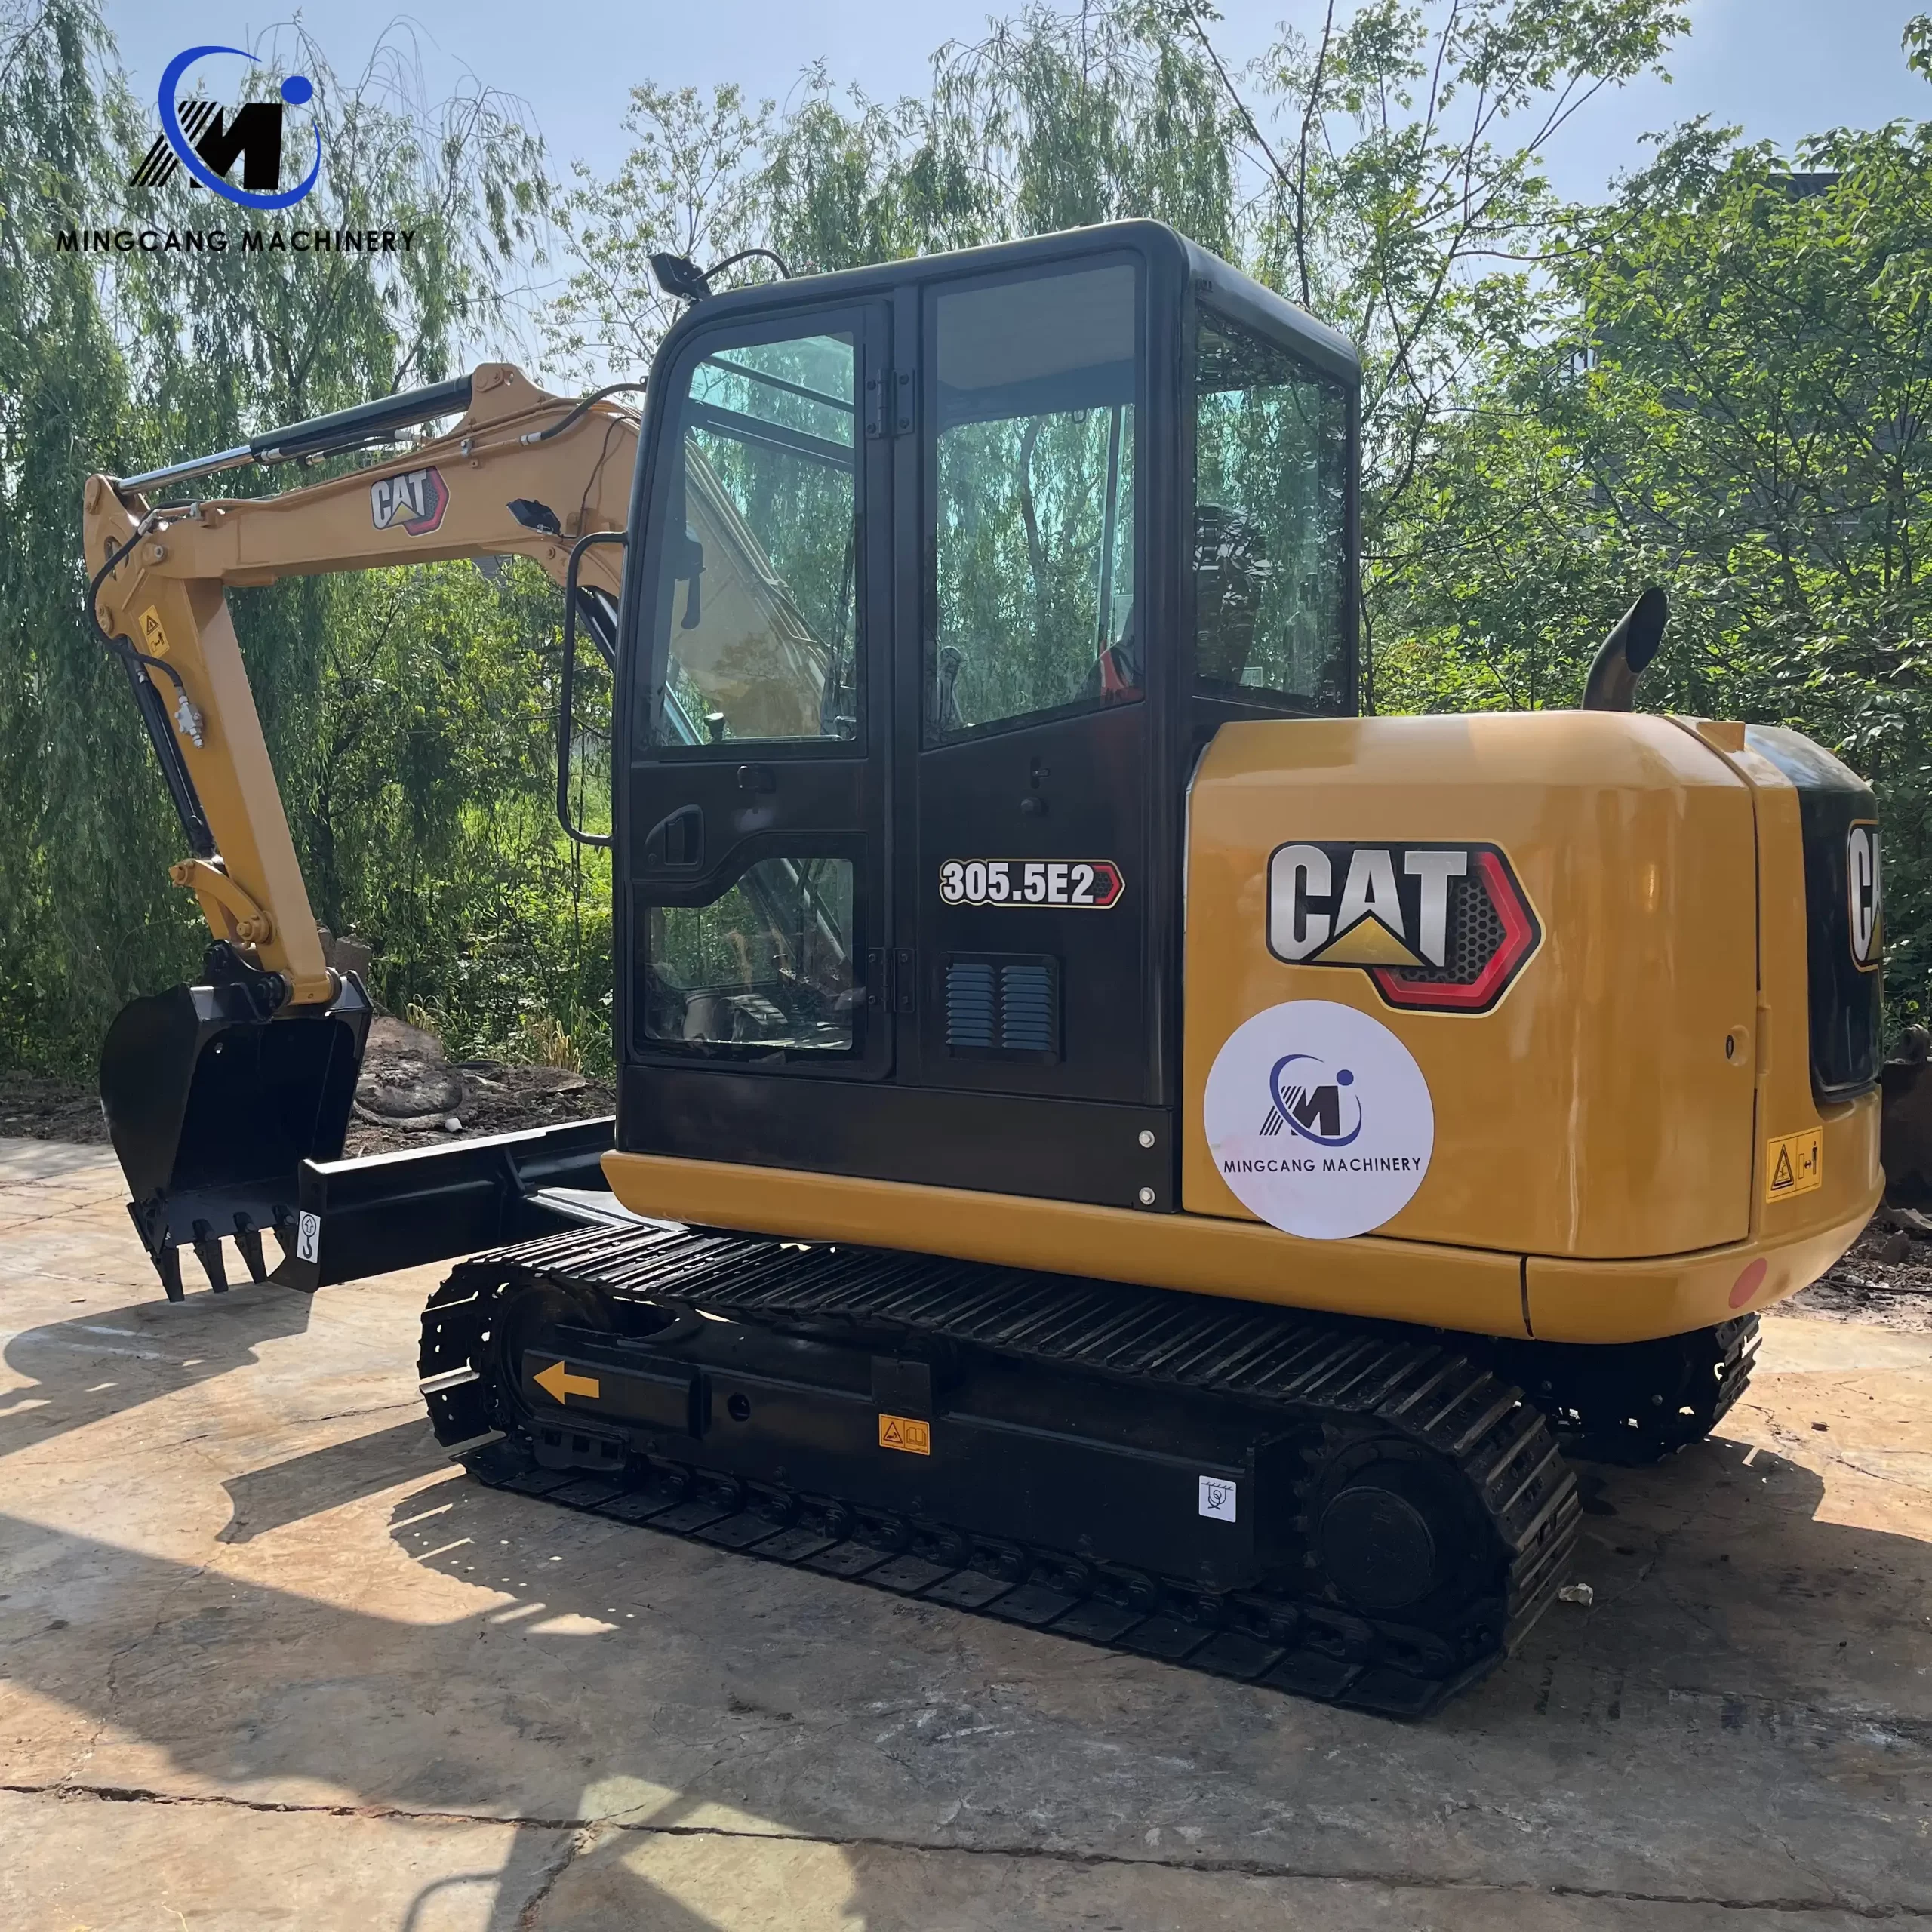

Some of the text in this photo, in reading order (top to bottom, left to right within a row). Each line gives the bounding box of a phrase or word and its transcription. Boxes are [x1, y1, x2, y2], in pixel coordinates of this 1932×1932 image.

[371, 469, 427, 529] CAT
[943, 862, 1095, 903] 305.5E2
[1270, 844, 1468, 968] CAT
[1223, 1157, 1422, 1174] MINGCANG MACHINERY
